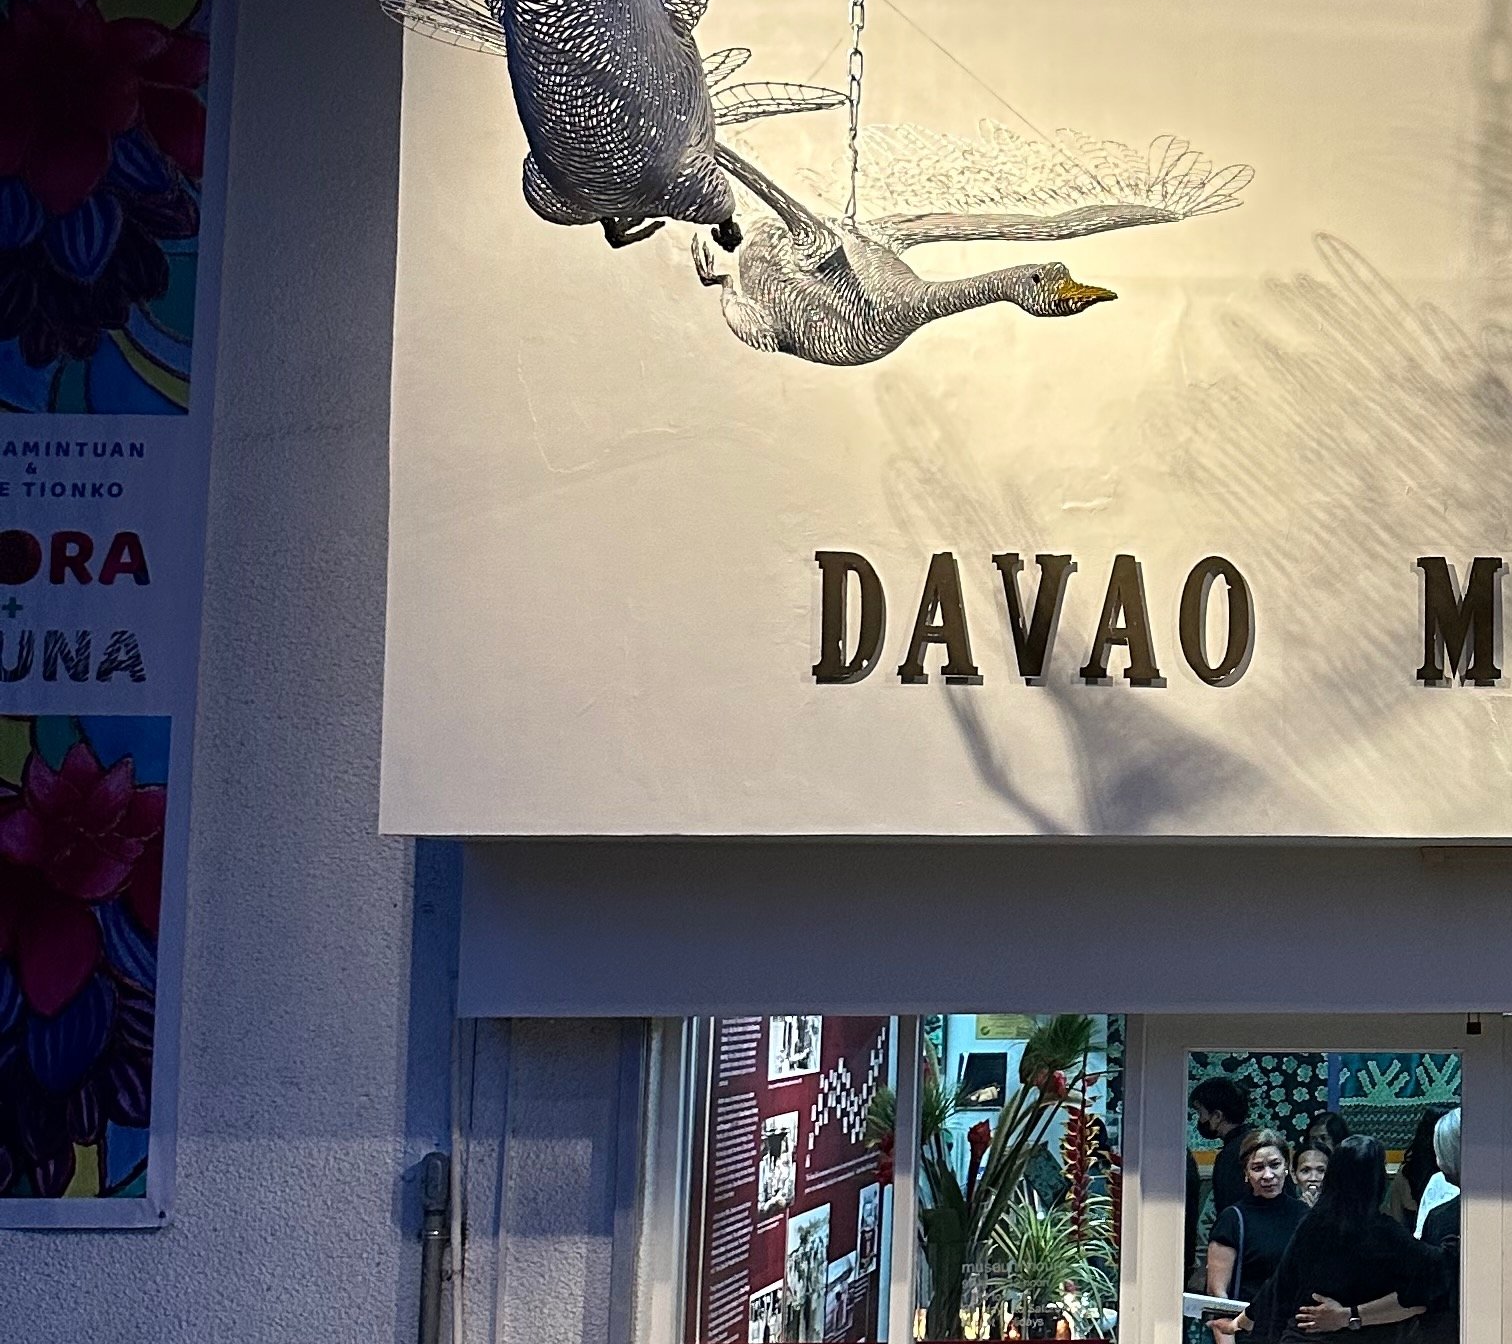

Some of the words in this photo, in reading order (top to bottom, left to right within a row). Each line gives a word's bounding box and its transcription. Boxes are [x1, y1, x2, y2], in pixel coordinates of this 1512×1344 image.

[3, 441, 145, 458] AMINTUAN
[25, 462, 37, 474] &
[22, 482, 124, 497] TIONKO
[0, 529, 150, 585] ORA
[812, 550, 1254, 687] DAVAO
